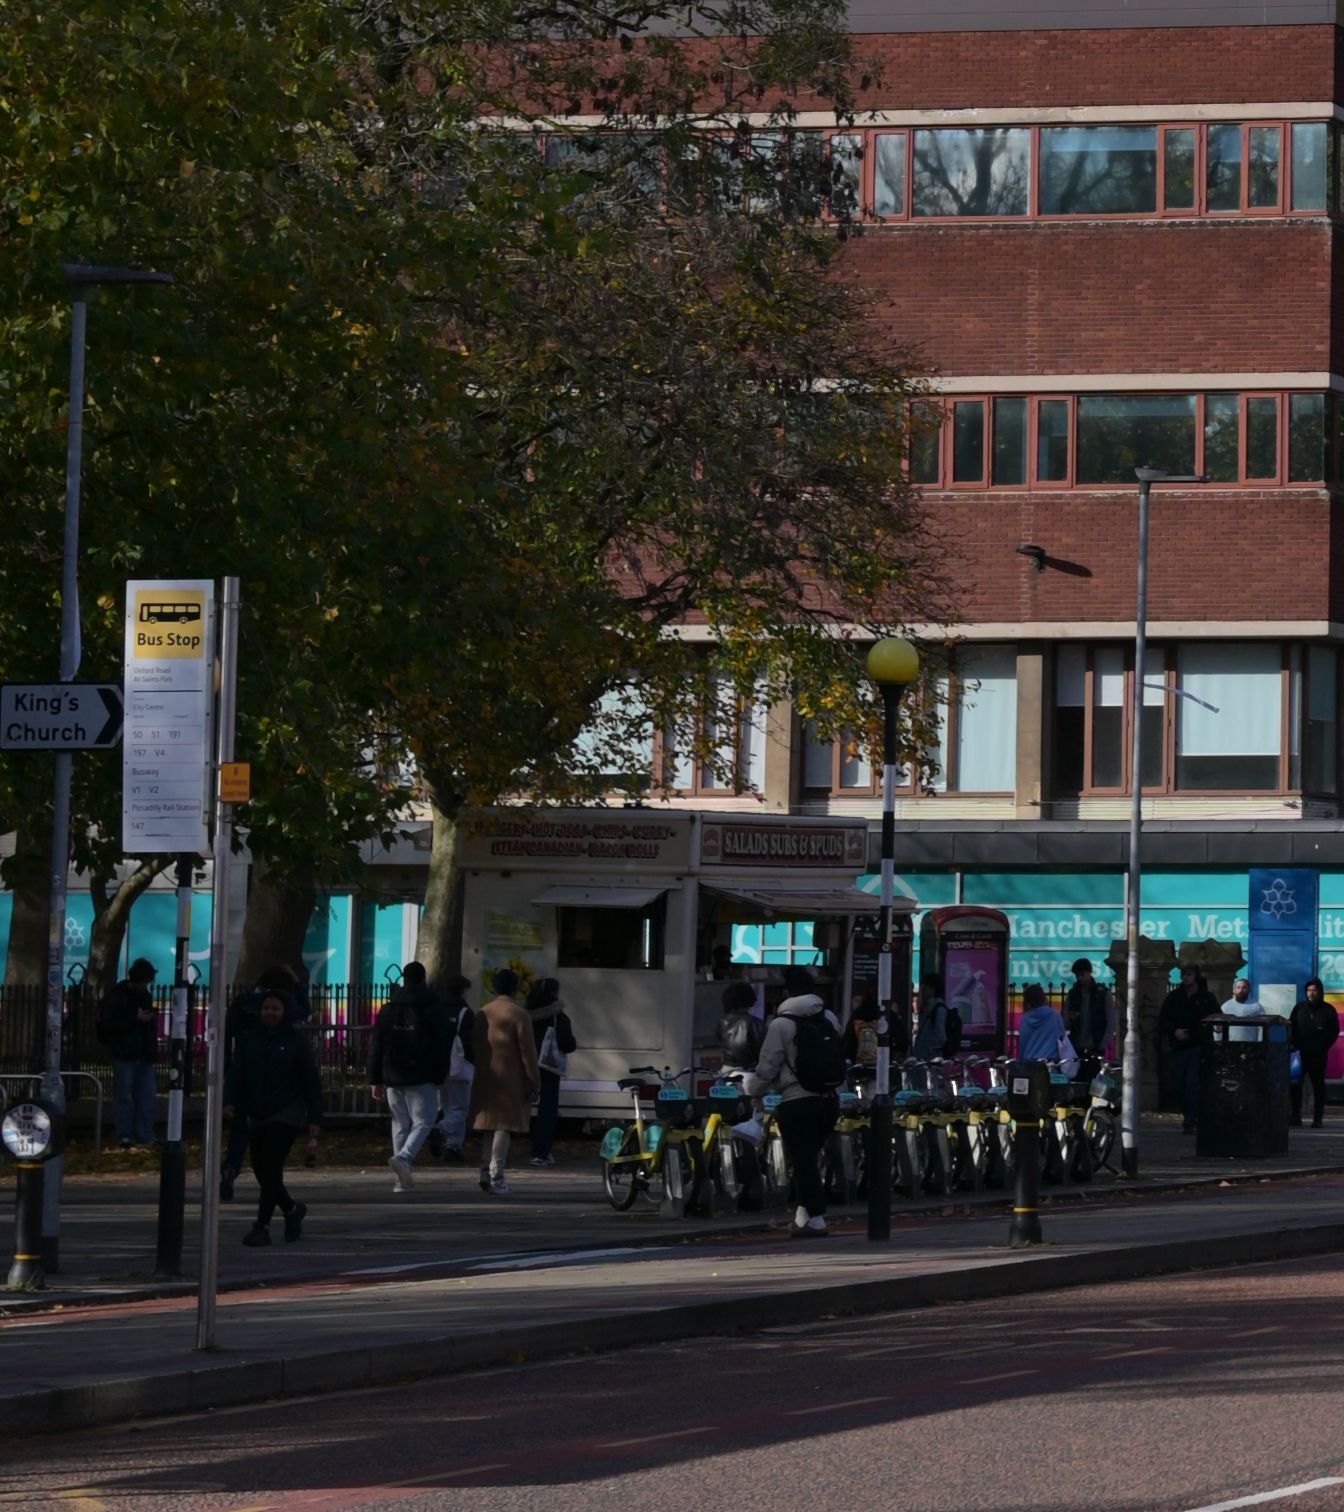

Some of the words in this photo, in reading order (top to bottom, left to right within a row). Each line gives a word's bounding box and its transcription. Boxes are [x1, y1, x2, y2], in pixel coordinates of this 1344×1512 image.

[137, 632, 163, 646] Bus
[166, 632, 201, 650] Stop
[14, 691, 80, 715] King's
[6, 722, 86, 742] Church
[149, 786, 159, 794] V2
[724, 831, 769, 855] SALADS
[769, 833, 798, 857] SUBS
[799, 836, 809, 856] &
[809, 834, 843, 857] SPUDS
[1009, 913, 1170, 939] ancheser
